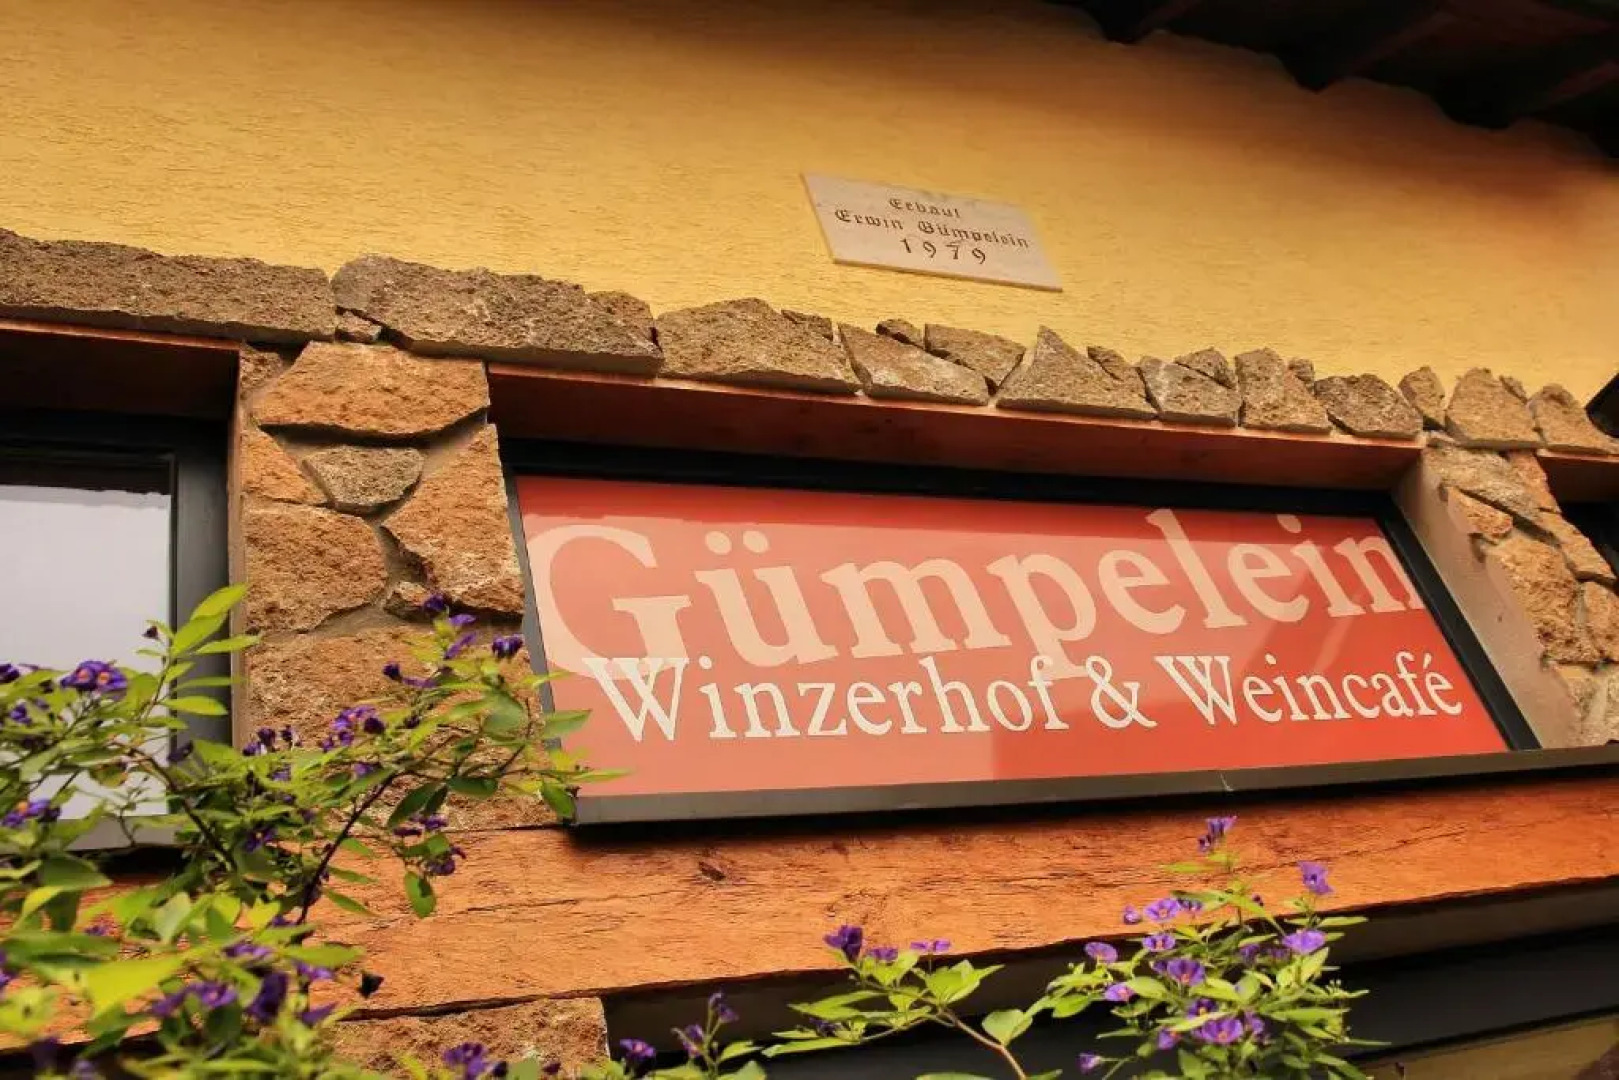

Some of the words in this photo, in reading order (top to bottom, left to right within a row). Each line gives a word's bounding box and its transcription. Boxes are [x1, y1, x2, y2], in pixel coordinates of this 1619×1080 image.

[834, 209, 904, 230] Erwin
[889, 198, 961, 219] Erbaut
[900, 237, 987, 265] 1979
[526, 508, 1425, 682] Gümpelein
[581, 655, 1070, 742] Winzerhof
[1084, 654, 1158, 730] &
[1155, 650, 1463, 727] Weincafé
